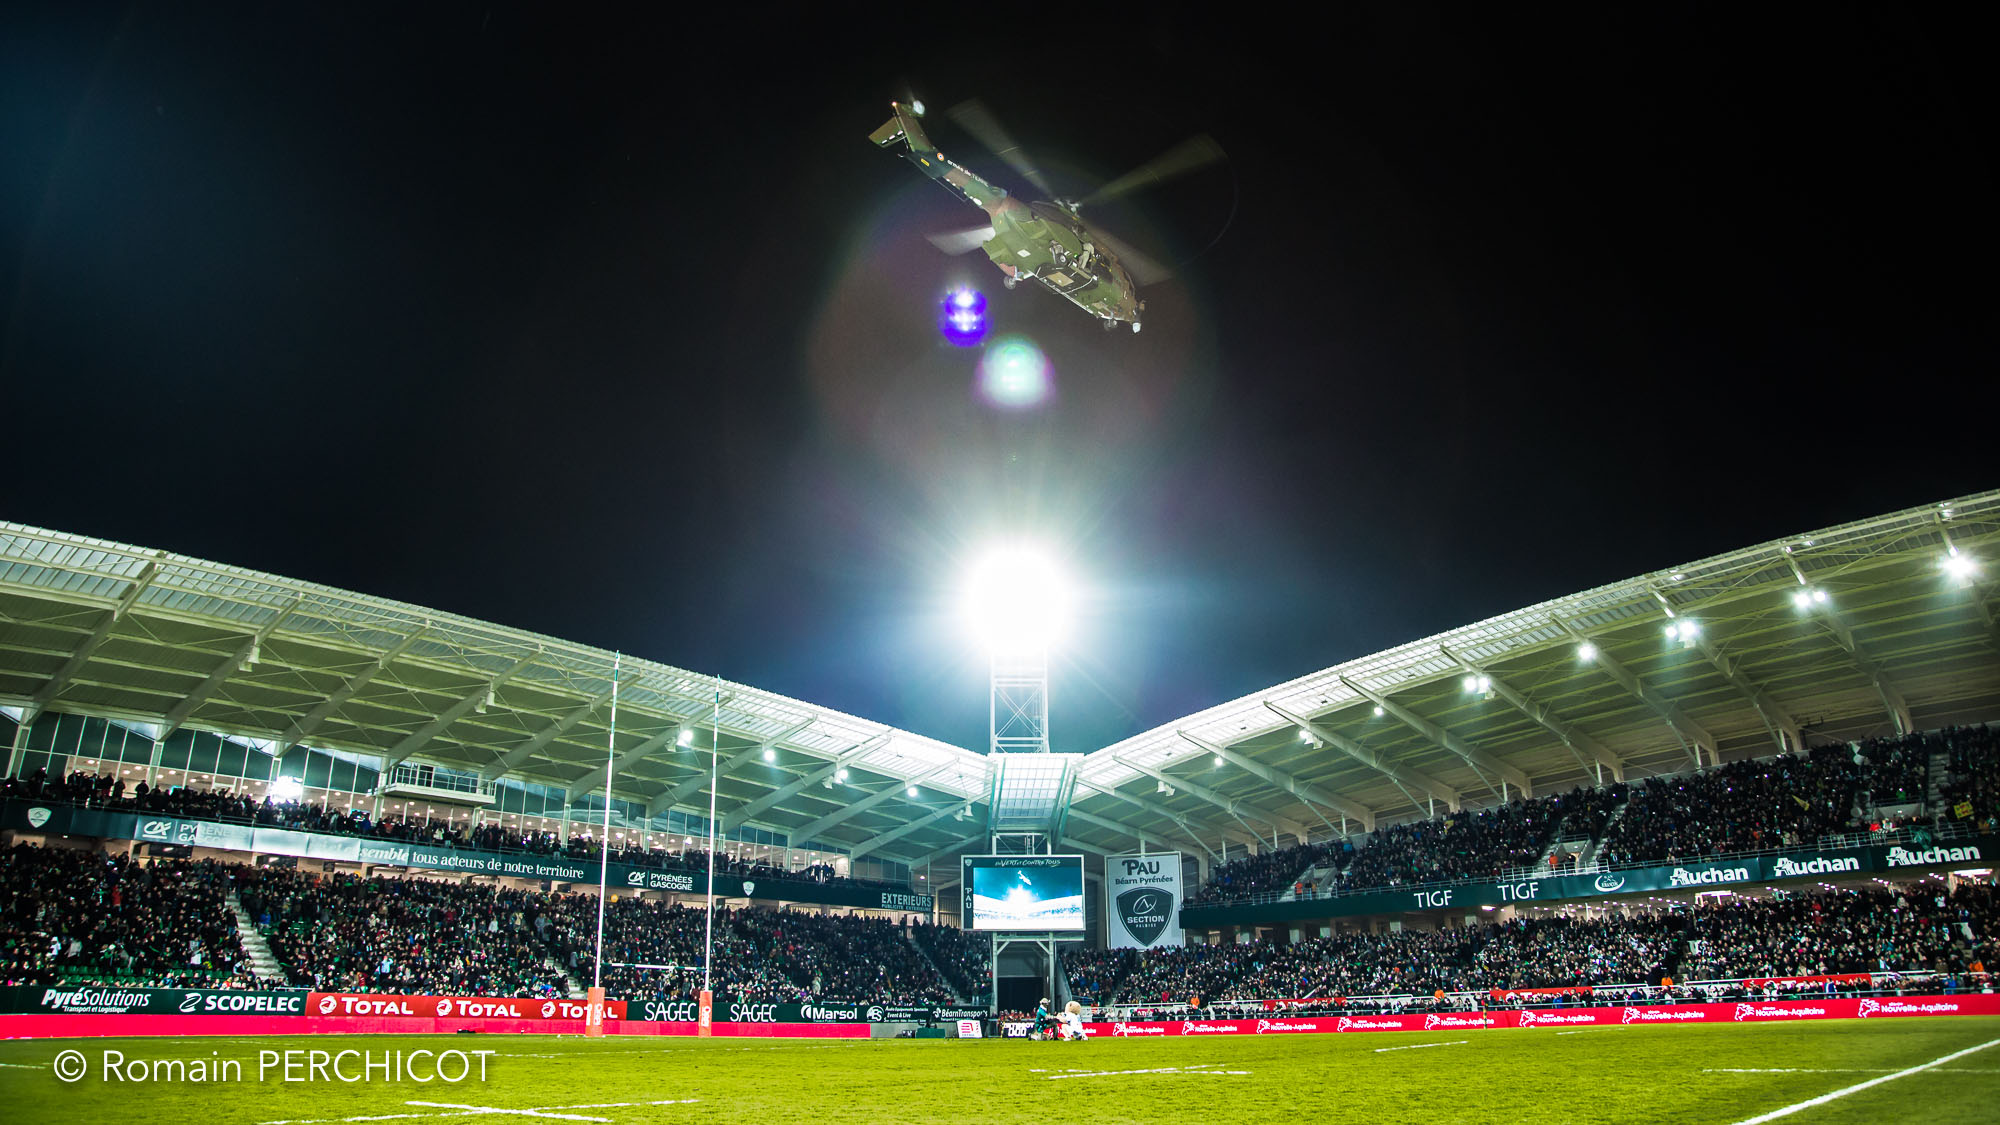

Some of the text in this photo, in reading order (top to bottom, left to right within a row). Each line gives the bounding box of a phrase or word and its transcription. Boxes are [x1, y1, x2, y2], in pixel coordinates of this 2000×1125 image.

[412, 851, 438, 865] tous
[440, 855, 485, 869] acteurs
[487, 858, 502, 871] de
[504, 861, 534, 874] notre
[536, 864, 584, 879] territoire
[1885, 846, 1981, 867] Auchan
[1122, 859, 1160, 876] PAU
[1773, 857, 1860, 876] Auchan
[650, 873, 693, 884] PYRÉNÉES
[1115, 875, 1173, 885] Béarn Pyrénées
[1670, 867, 1749, 886] Auchan
[650, 880, 693, 891] GASCOGNE
[1497, 882, 1539, 901] TIGF
[881, 892, 932, 907] EXTERIEURS
[1413, 890, 1452, 908] TIGF
[1127, 915, 1165, 924] SECTION
[41, 987, 152, 1009] PyréSolutions
[204, 995, 301, 1012] SCOPELEC
[341, 997, 414, 1015] TOTAL
[456, 1000, 522, 1017] TOTAL
[644, 1002, 697, 1022] SAGEC
[729, 1004, 777, 1023] SAGEC
[812, 1007, 858, 1020] Marsol
[1641, 1010, 1705, 1020] Nouvelle-Aquitaine
[1756, 1007, 1825, 1017] Nouvelle-Aquitaine
[1881, 1003, 1958, 1013] Nouvelle-Aquitaine
[1536, 1014, 1595, 1023] Nouvelle-Aquitaine
